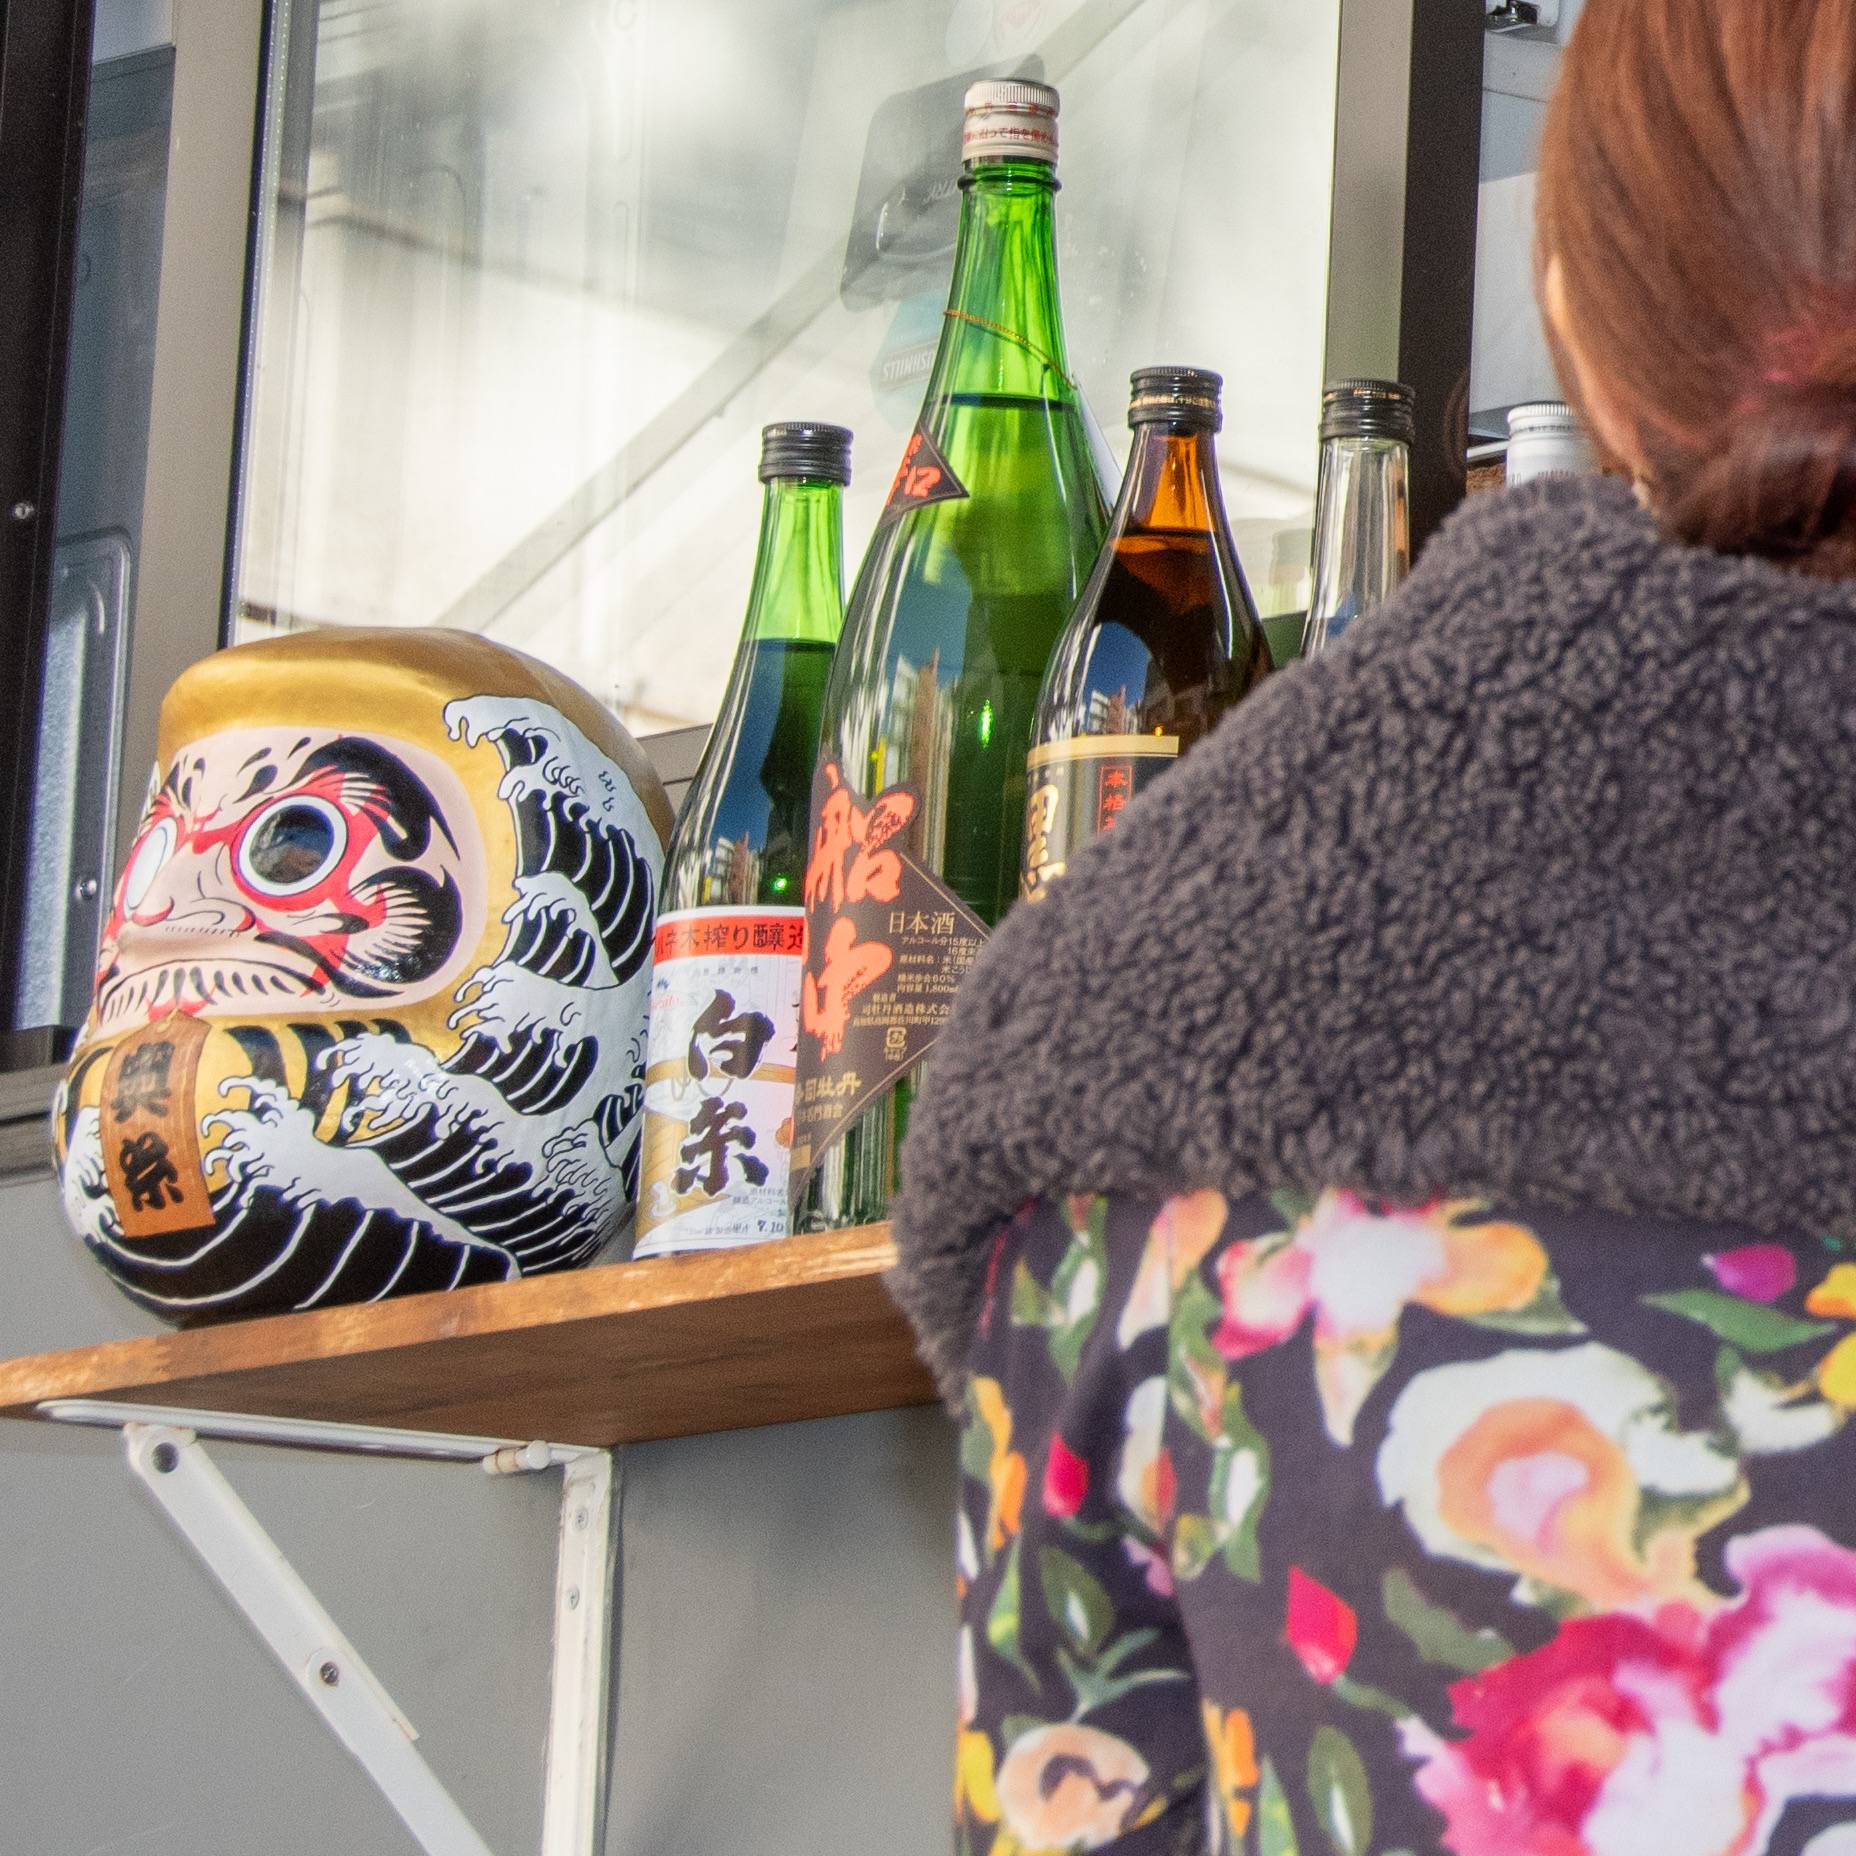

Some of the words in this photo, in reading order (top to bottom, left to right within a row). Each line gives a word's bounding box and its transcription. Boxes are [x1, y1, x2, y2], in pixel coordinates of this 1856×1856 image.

[889, 910, 956, 935] 日本酒
[671, 989, 776, 1197] 白糸
